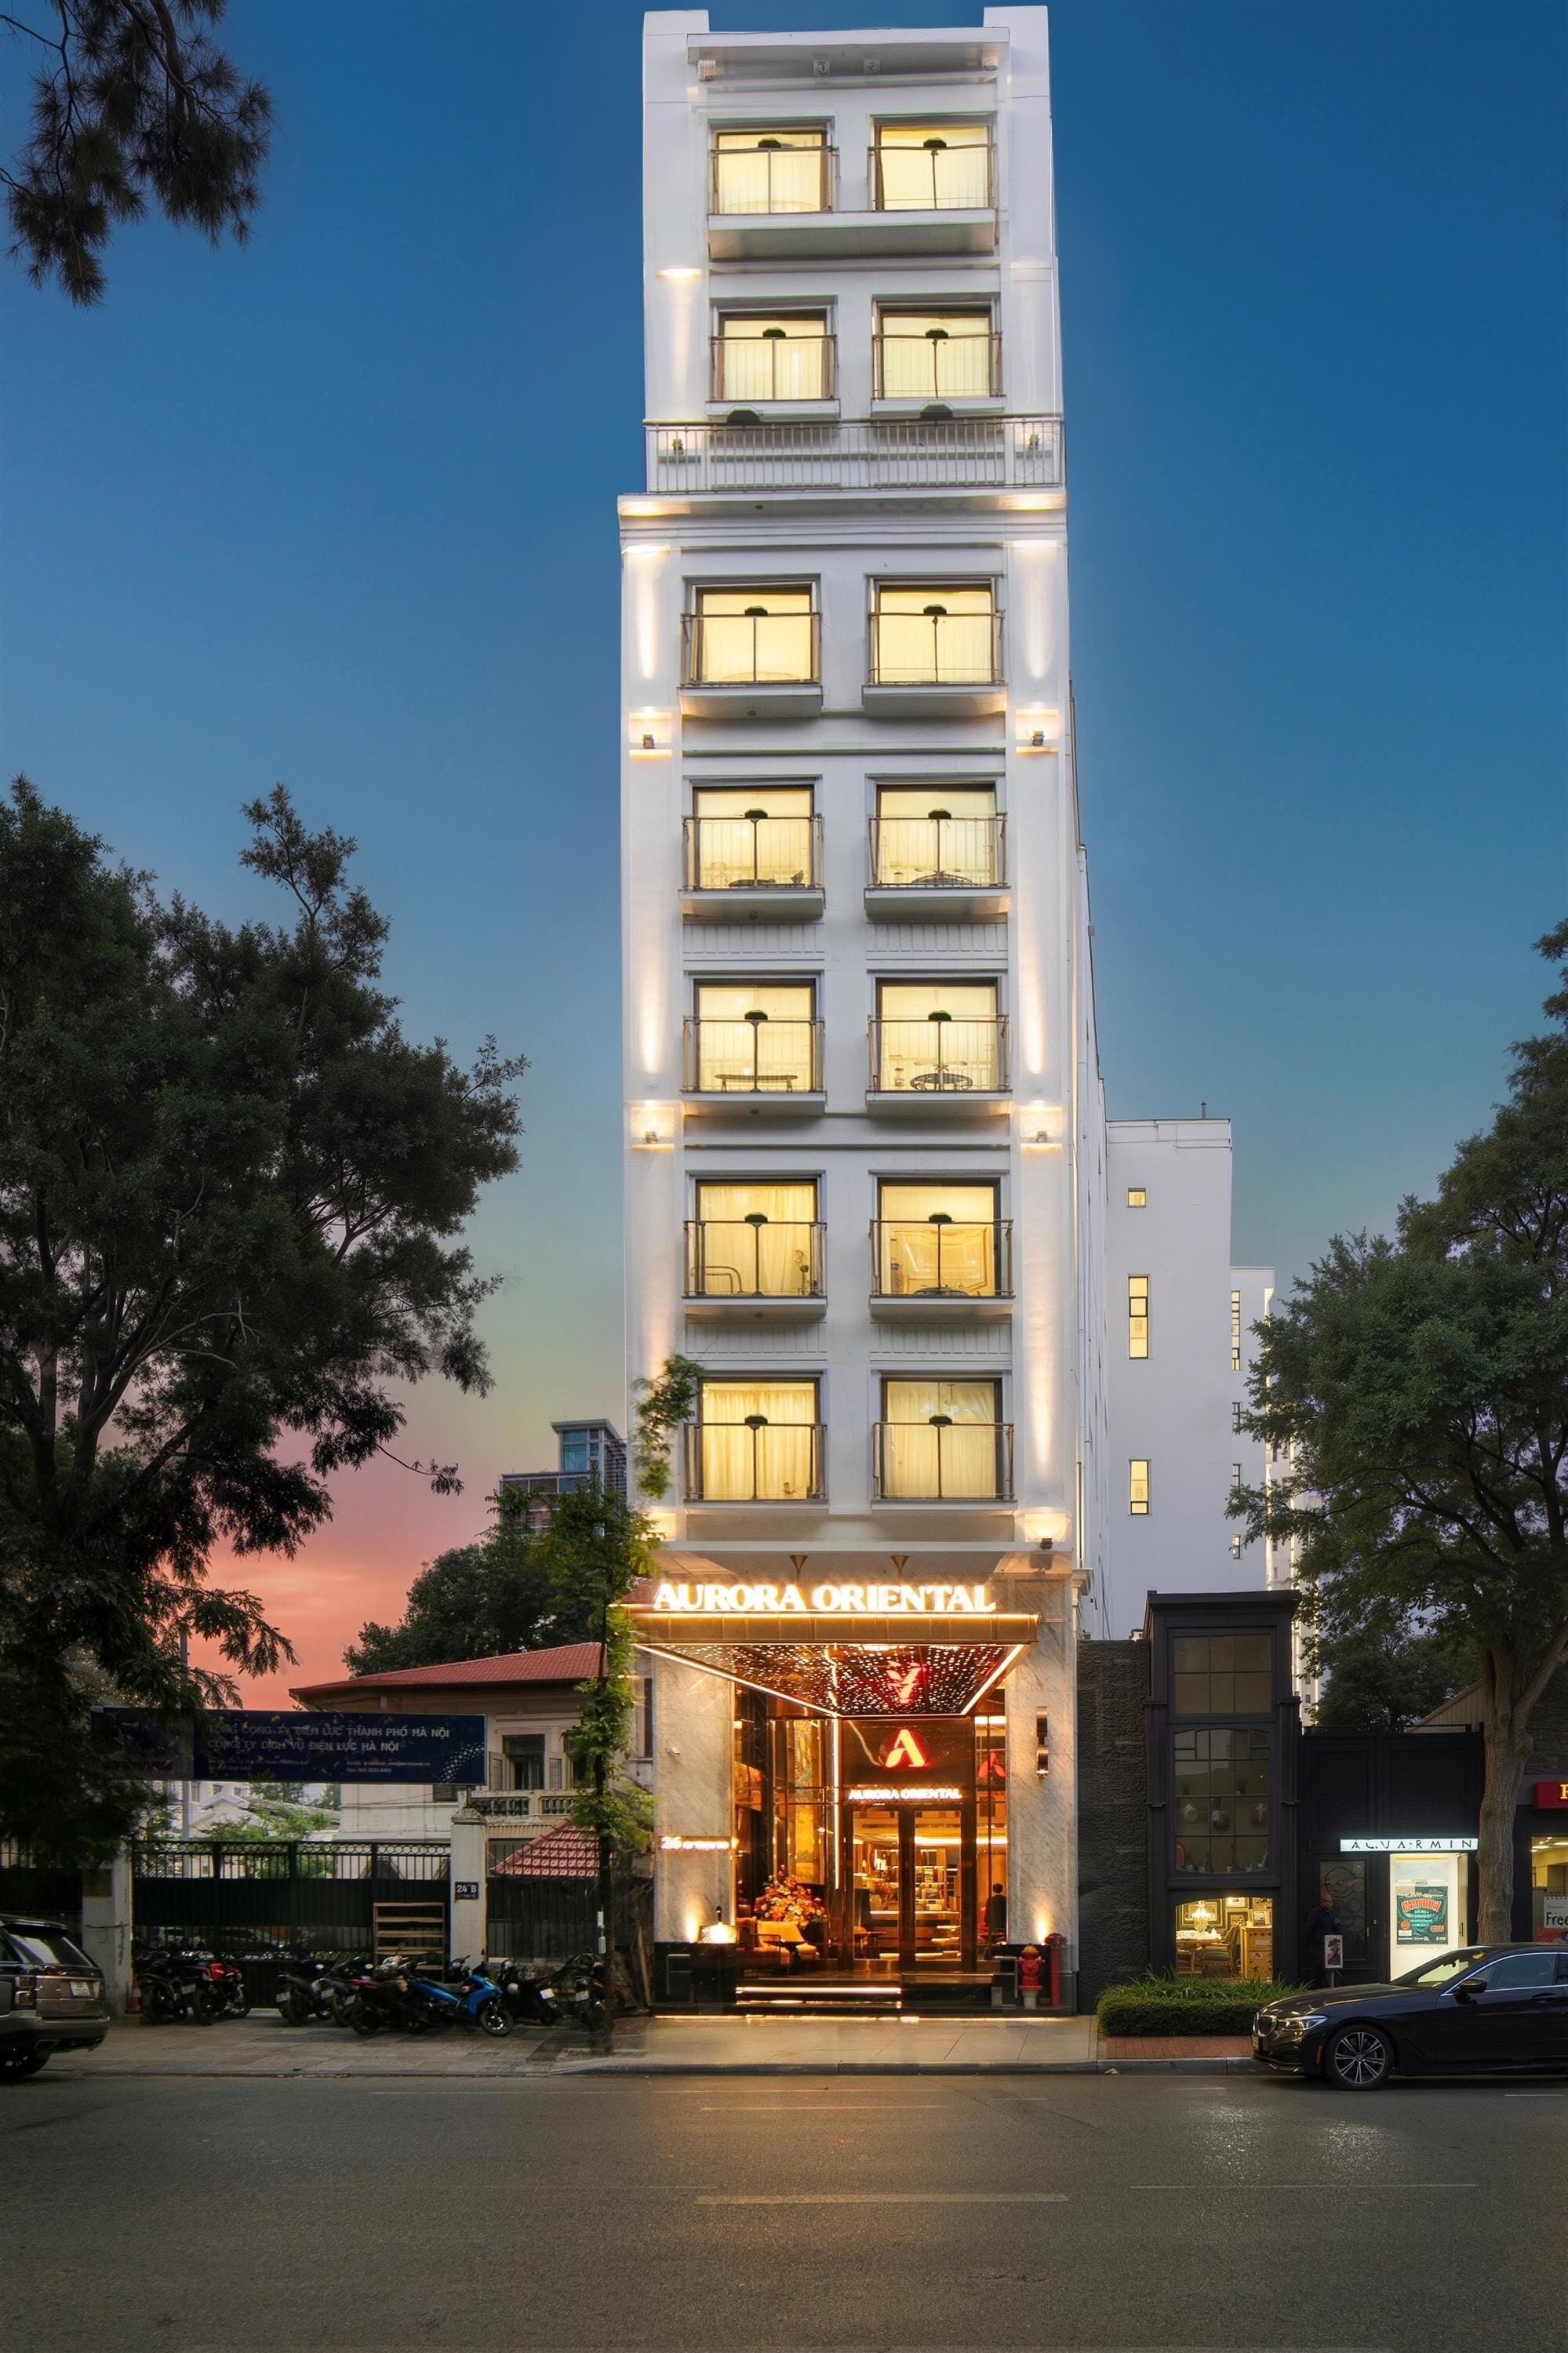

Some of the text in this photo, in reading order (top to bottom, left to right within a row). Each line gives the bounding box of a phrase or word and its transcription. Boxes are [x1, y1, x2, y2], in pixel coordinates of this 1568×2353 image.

[653, 1584, 996, 1613] AURORA ORIENTAL
[385, 1724, 409, 1738] PHỐ
[412, 1726, 427, 1738] HÀ
[431, 1726, 449, 1740] NỘI
[362, 1740, 377, 1751] HÀ
[380, 1740, 398, 1752] NỘI
